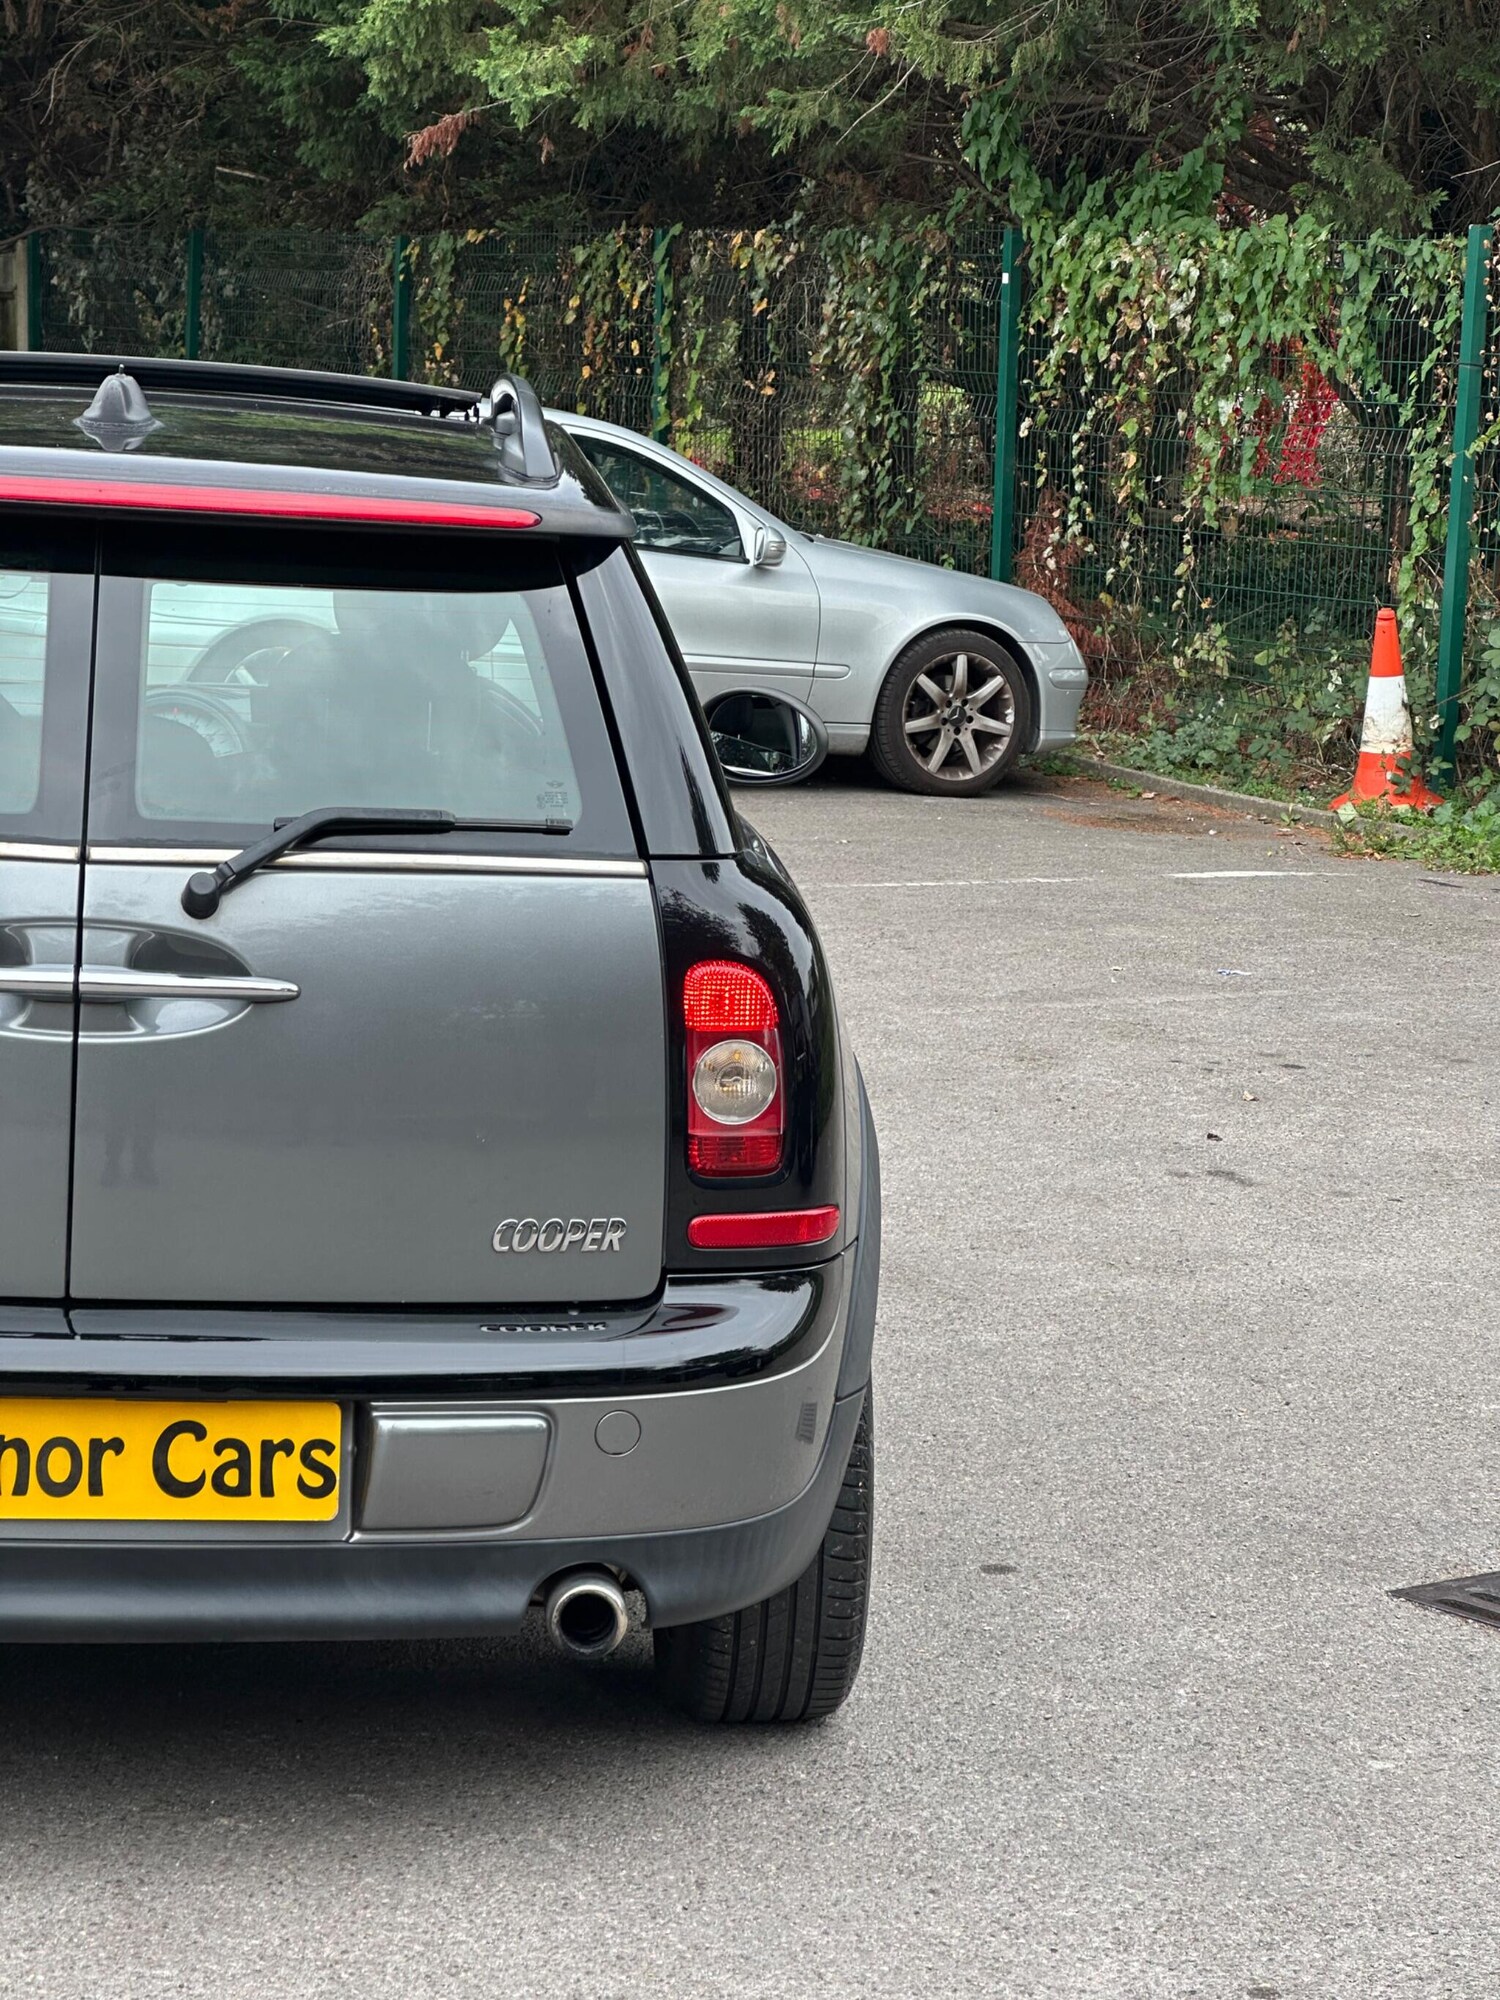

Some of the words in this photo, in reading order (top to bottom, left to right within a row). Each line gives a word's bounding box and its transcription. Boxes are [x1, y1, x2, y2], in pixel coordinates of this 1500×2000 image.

[492, 1217, 627, 1252] COOPER
[0, 1434, 125, 1498] nor
[152, 1419, 337, 1499] Cars
